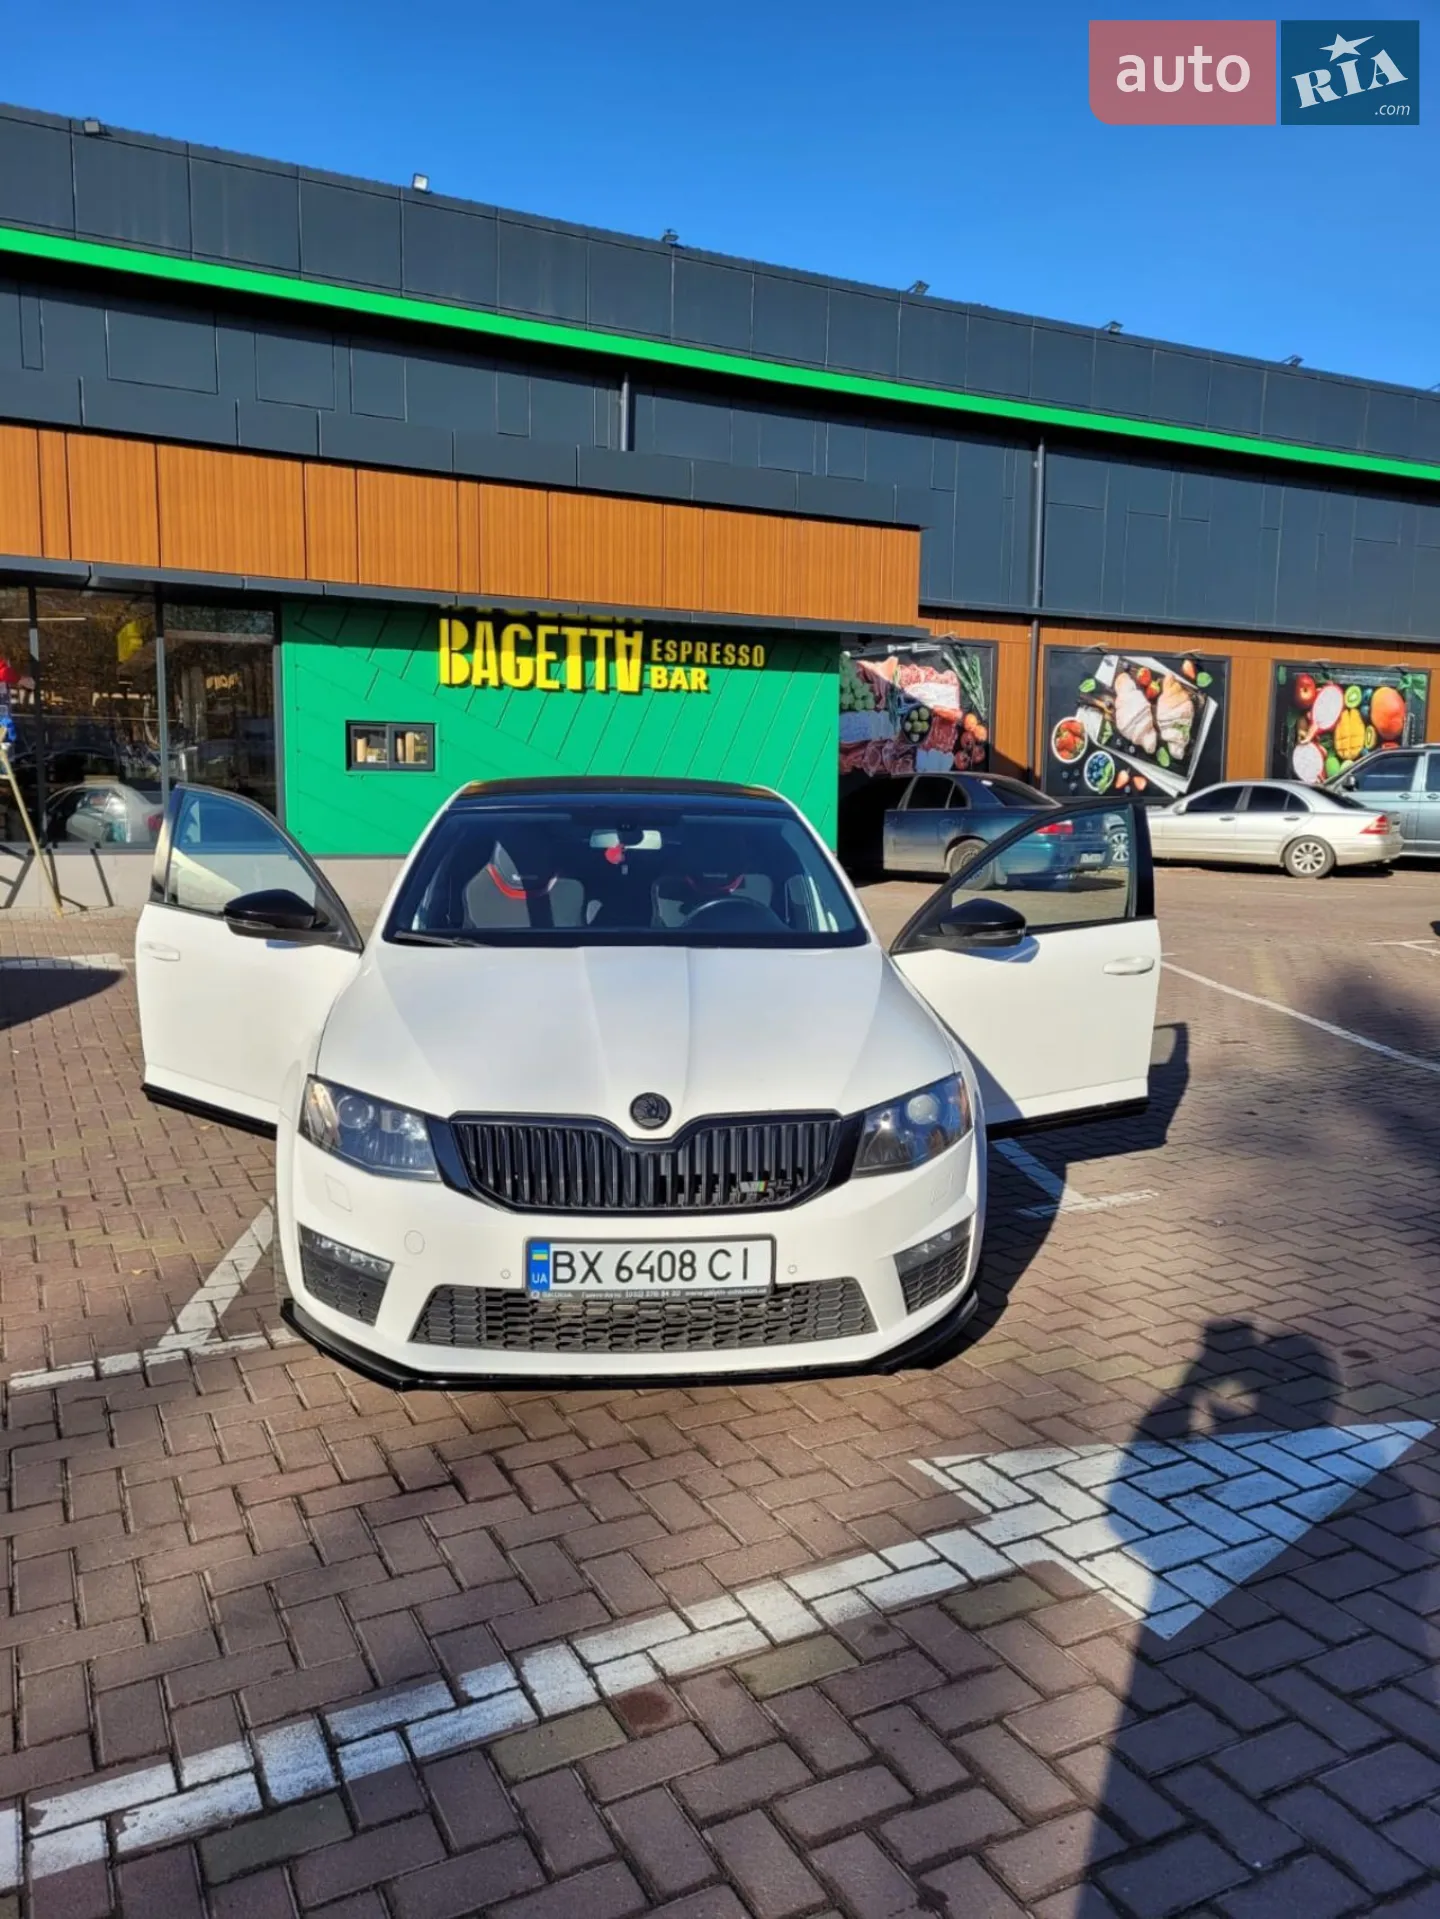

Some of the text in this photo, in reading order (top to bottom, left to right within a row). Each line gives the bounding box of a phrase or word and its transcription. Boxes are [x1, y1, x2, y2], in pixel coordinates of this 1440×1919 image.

[438, 617, 644, 693] BAGETTA
[651, 638, 766, 668] ESPRESSO
[651, 666, 709, 692] BAR
[531, 1273, 548, 1284] UA
[552, 1247, 749, 1284] BX 6408 CI
